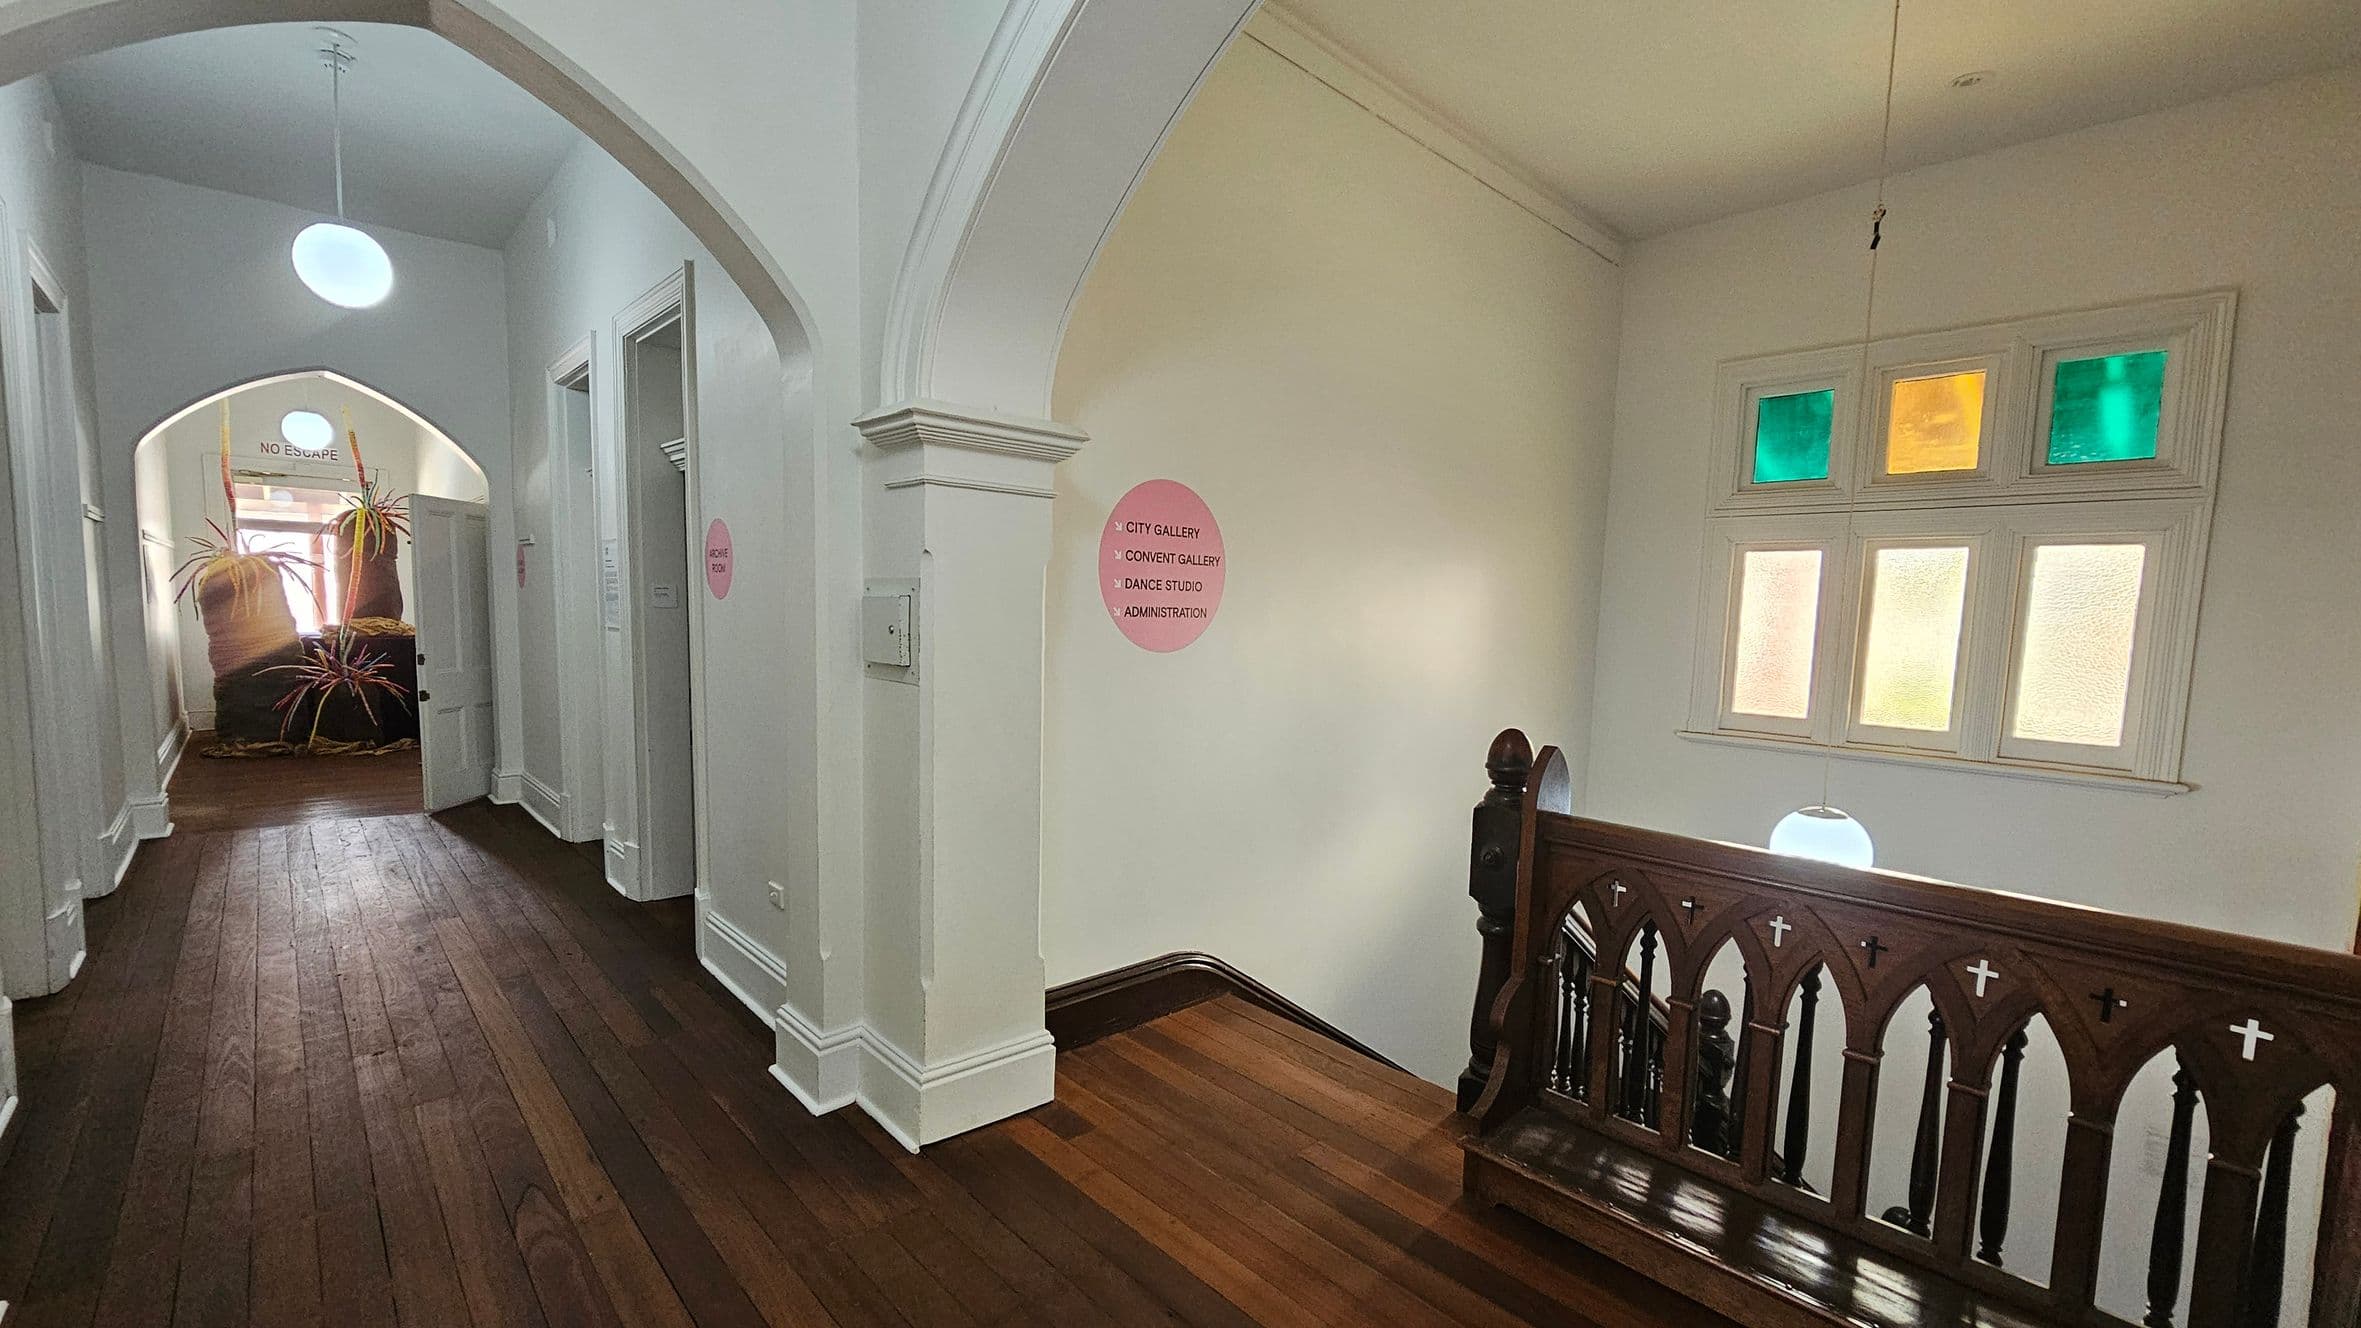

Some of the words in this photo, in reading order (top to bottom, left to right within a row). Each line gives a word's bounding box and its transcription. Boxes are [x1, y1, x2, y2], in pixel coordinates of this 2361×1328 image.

[260, 442, 280, 454] NO
[1126, 521, 1151, 535] CITY
[1154, 524, 1200, 539] GALLERY
[1125, 549, 1176, 564] CONVENT
[1178, 553, 1221, 567] GALLERY
[1124, 577, 1163, 591] DANCE
[1165, 579, 1203, 592] STUDIO
[1124, 606, 1207, 619] ADMINISTRATION
